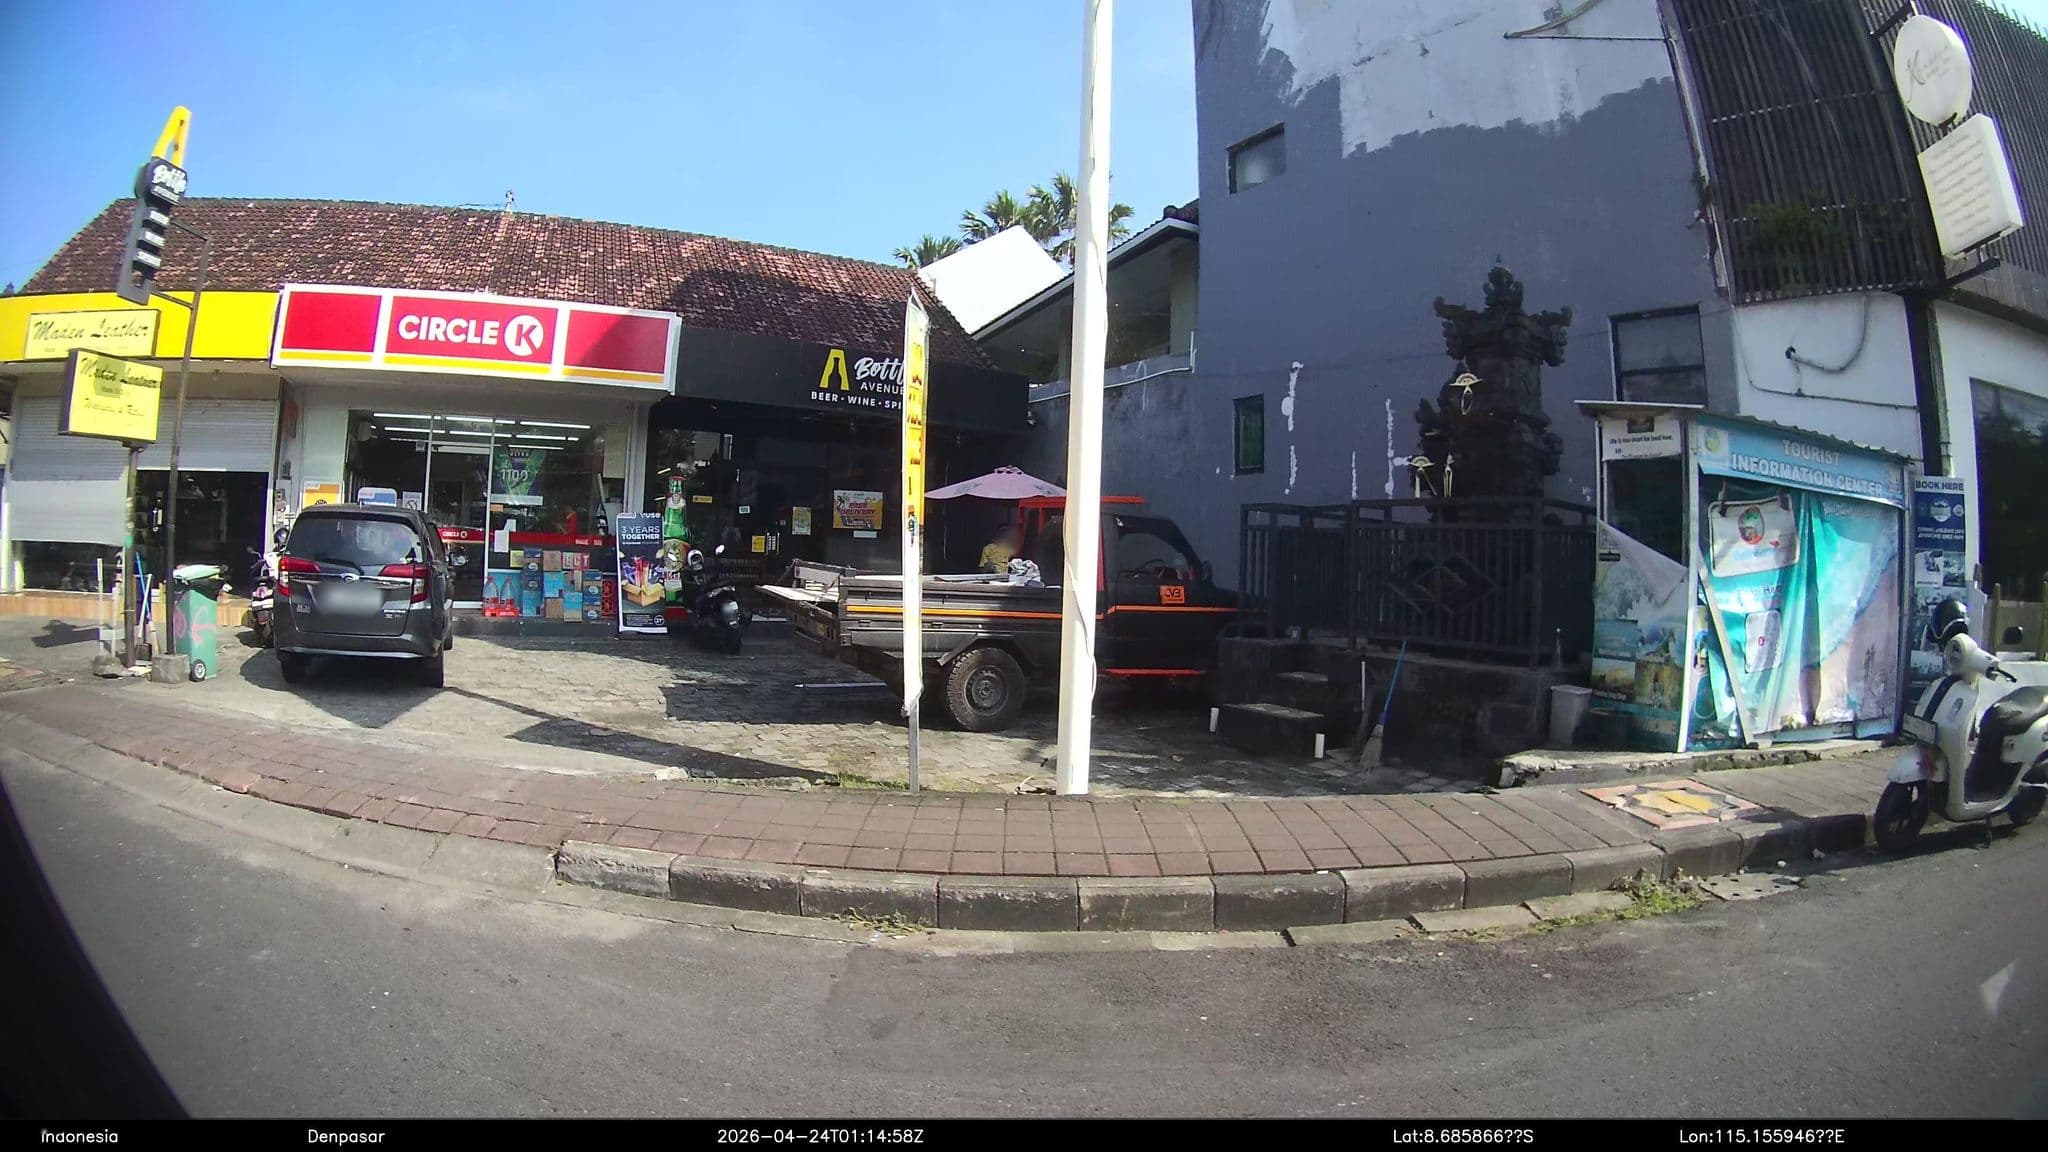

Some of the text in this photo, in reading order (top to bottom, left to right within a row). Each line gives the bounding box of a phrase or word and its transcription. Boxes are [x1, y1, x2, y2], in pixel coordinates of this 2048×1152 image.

[398, 314, 541, 355] CIRCLE K
[854, 357, 904, 385] Bottl
[811, 391, 839, 402] BEER
[847, 395, 876, 406] WINE
[1782, 439, 1841, 467] TOURIST
[1731, 453, 1883, 497] INFORMATION CENTER
[1915, 481, 1965, 491] BOOK HERE
